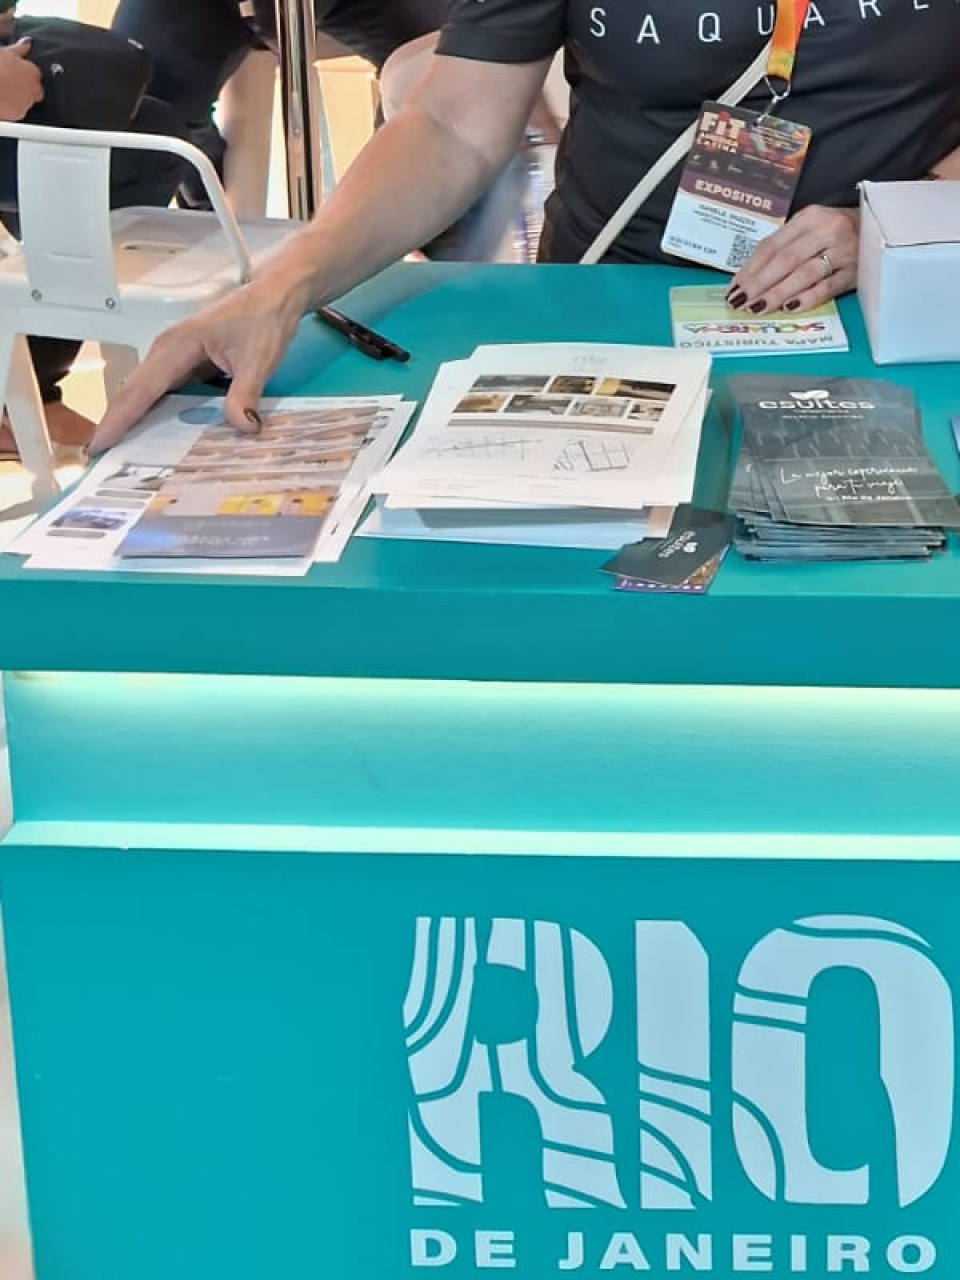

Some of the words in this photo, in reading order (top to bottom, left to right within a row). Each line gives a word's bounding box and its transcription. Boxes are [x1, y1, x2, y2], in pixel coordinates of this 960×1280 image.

[695, 179, 772, 210] EXPOSITOR
[402, 914, 955, 1209] RIO
[409, 1229, 516, 1268] DE
[558, 1231, 937, 1273] JANEIRO
